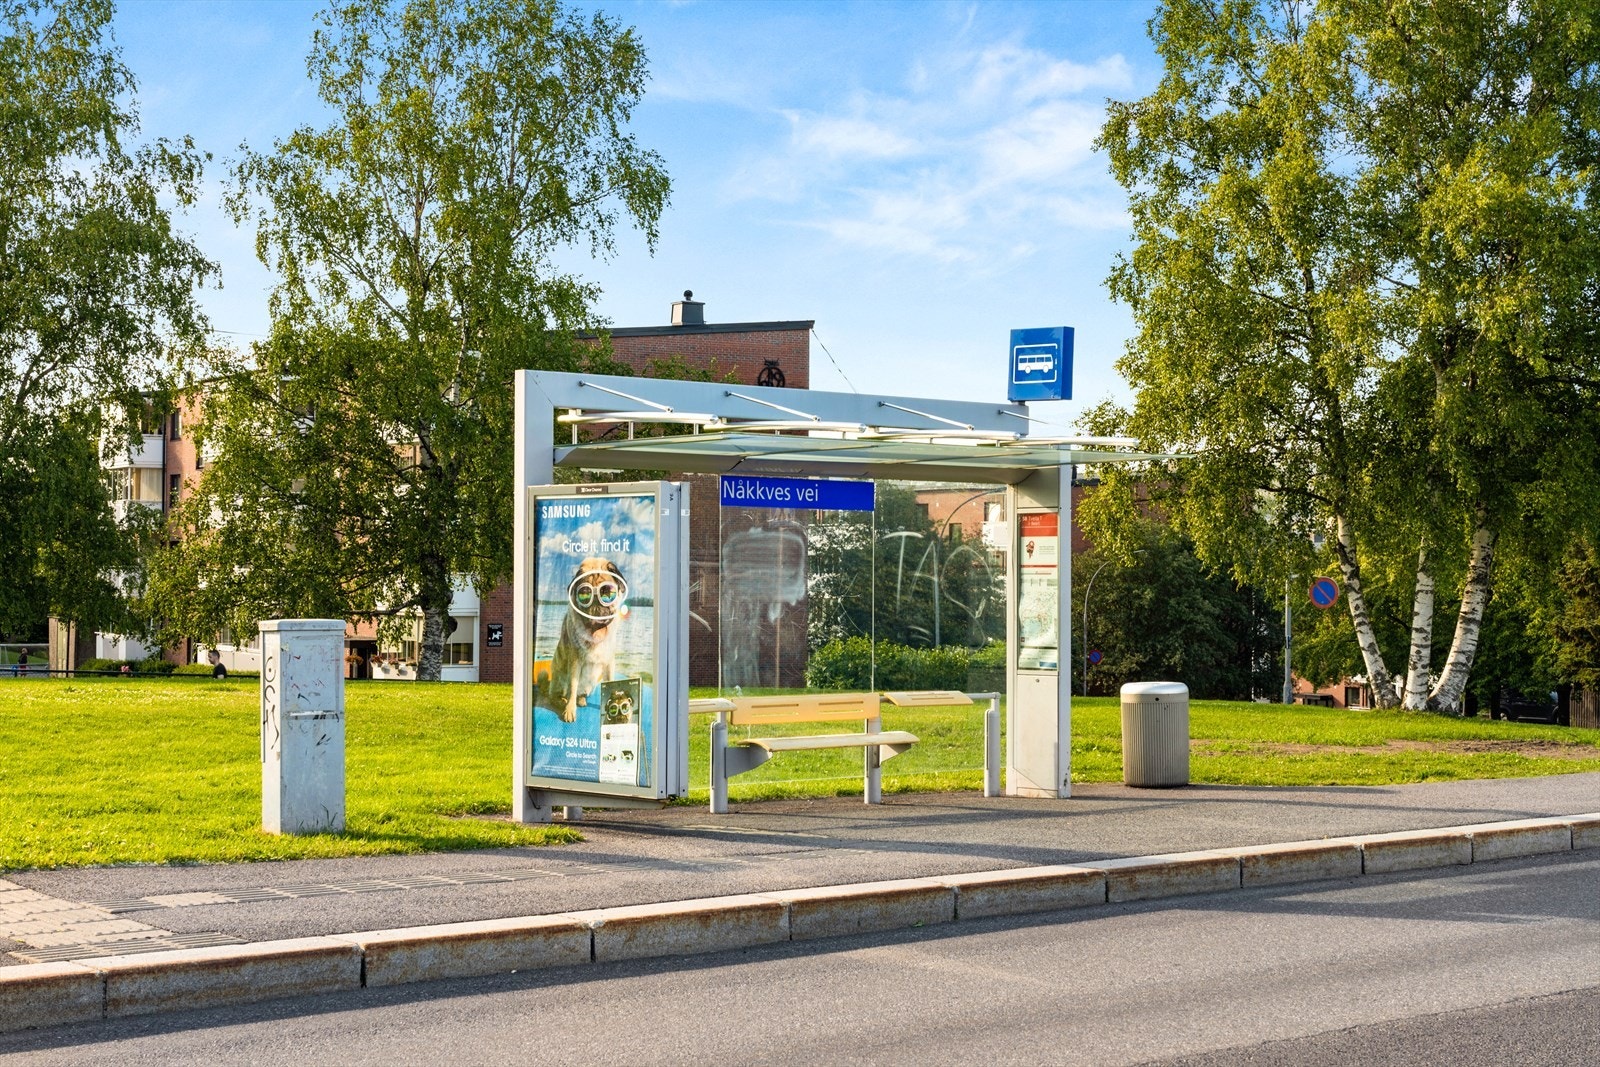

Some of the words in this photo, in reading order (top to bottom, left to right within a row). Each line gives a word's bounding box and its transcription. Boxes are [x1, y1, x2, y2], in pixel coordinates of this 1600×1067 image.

[723, 479, 791, 501] Nåkkves
[796, 483, 819, 502] vei
[542, 504, 591, 519] SAMSUNG
[562, 539, 589, 553] Circle
[601, 538, 621, 552] find
[623, 538, 630, 552] it
[539, 735, 565, 749] Galaxy
[565, 737, 578, 748] S24
[579, 738, 597, 749] Ultra
